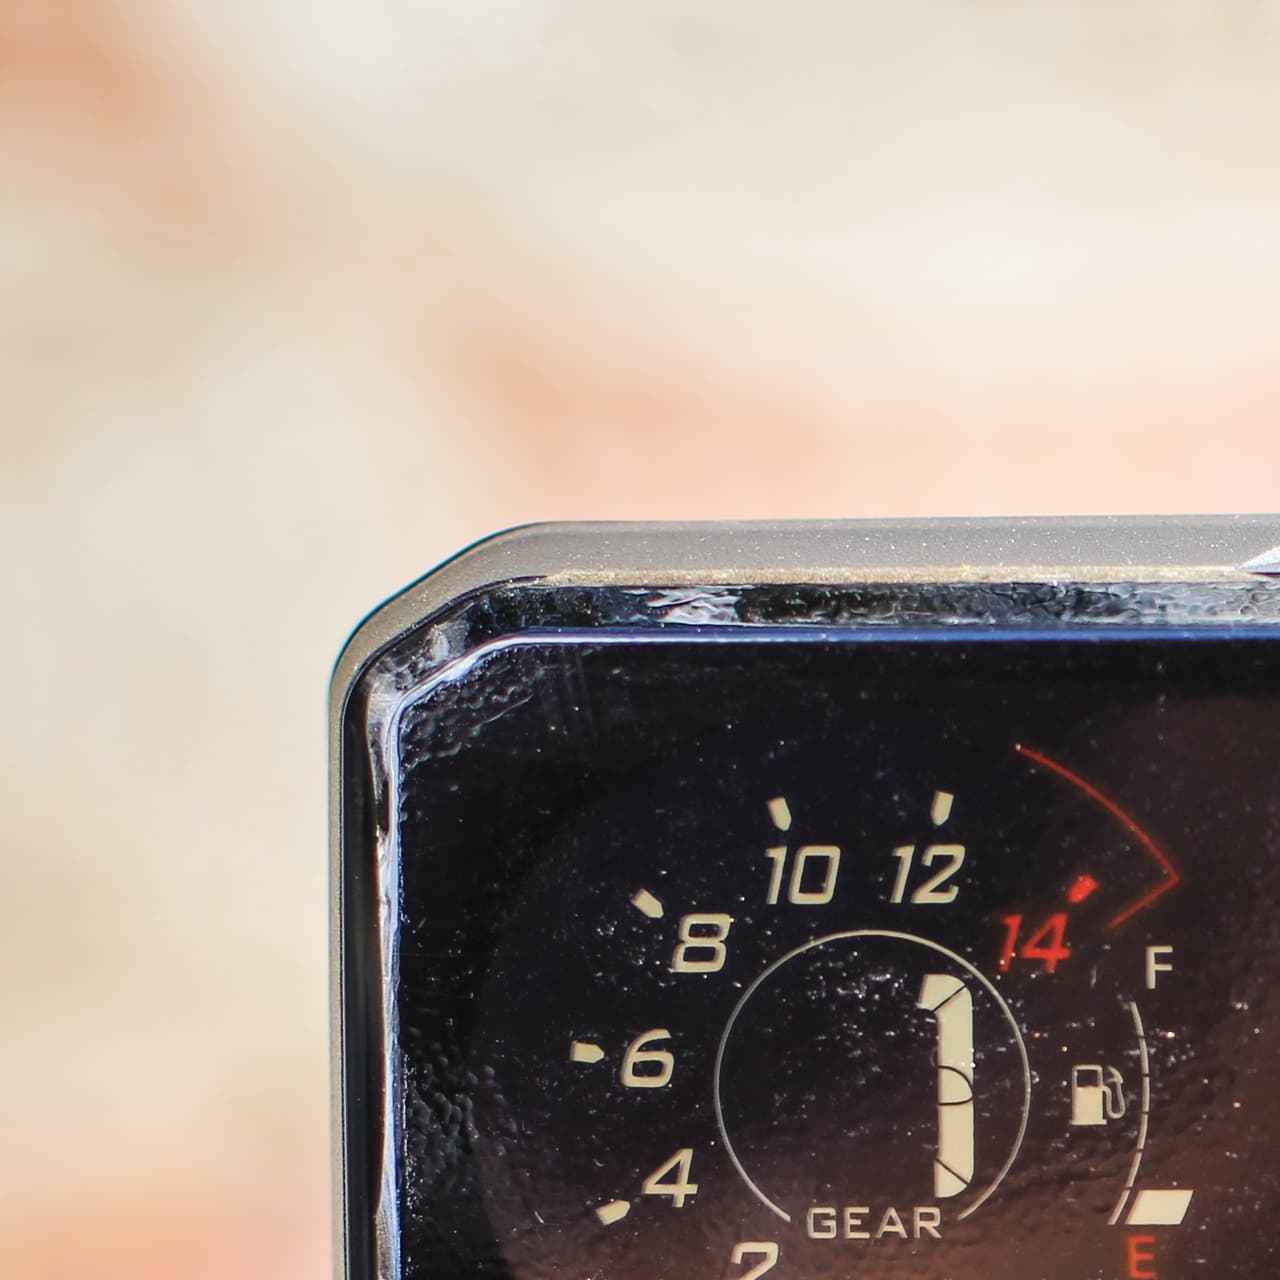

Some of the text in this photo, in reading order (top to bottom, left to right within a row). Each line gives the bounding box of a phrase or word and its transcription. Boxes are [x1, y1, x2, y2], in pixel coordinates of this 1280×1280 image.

[765, 845, 841, 904] 10
[890, 845, 966, 904] 12
[672, 913, 732, 973] 8
[1000, 913, 1071, 972] 14
[1146, 945, 1174, 989] F
[620, 1029, 674, 1088] 6
[918, 973, 974, 1198] 1
[642, 1148, 699, 1208] 4
[806, 1206, 942, 1240] GEAR
[1128, 1236, 1157, 1279] E
